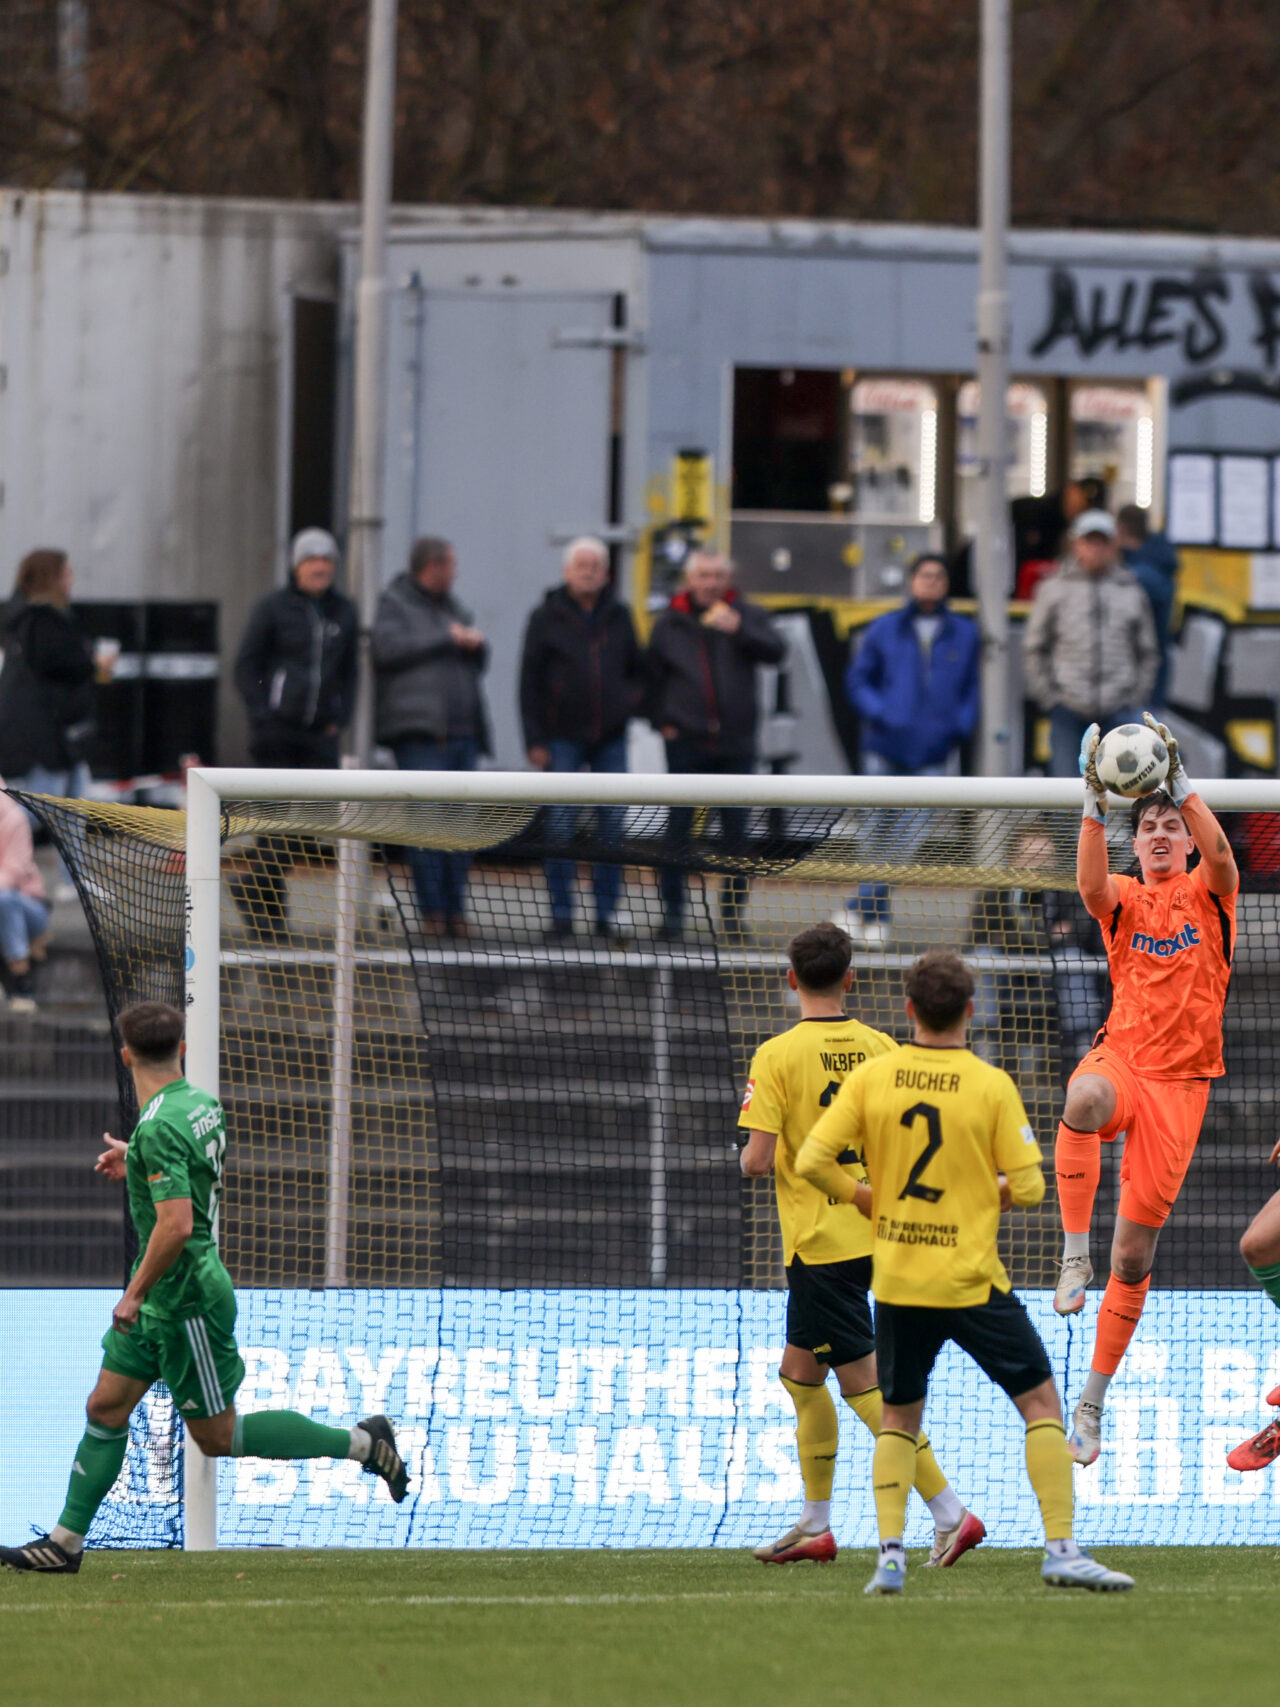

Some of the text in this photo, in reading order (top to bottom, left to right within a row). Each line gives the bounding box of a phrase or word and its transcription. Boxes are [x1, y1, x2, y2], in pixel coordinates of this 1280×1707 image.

[1030, 265, 1230, 365] ALLES
[1130, 923, 1200, 957] maxit
[894, 1069, 961, 1093] BUCHER
[897, 1102, 945, 1204] 2
